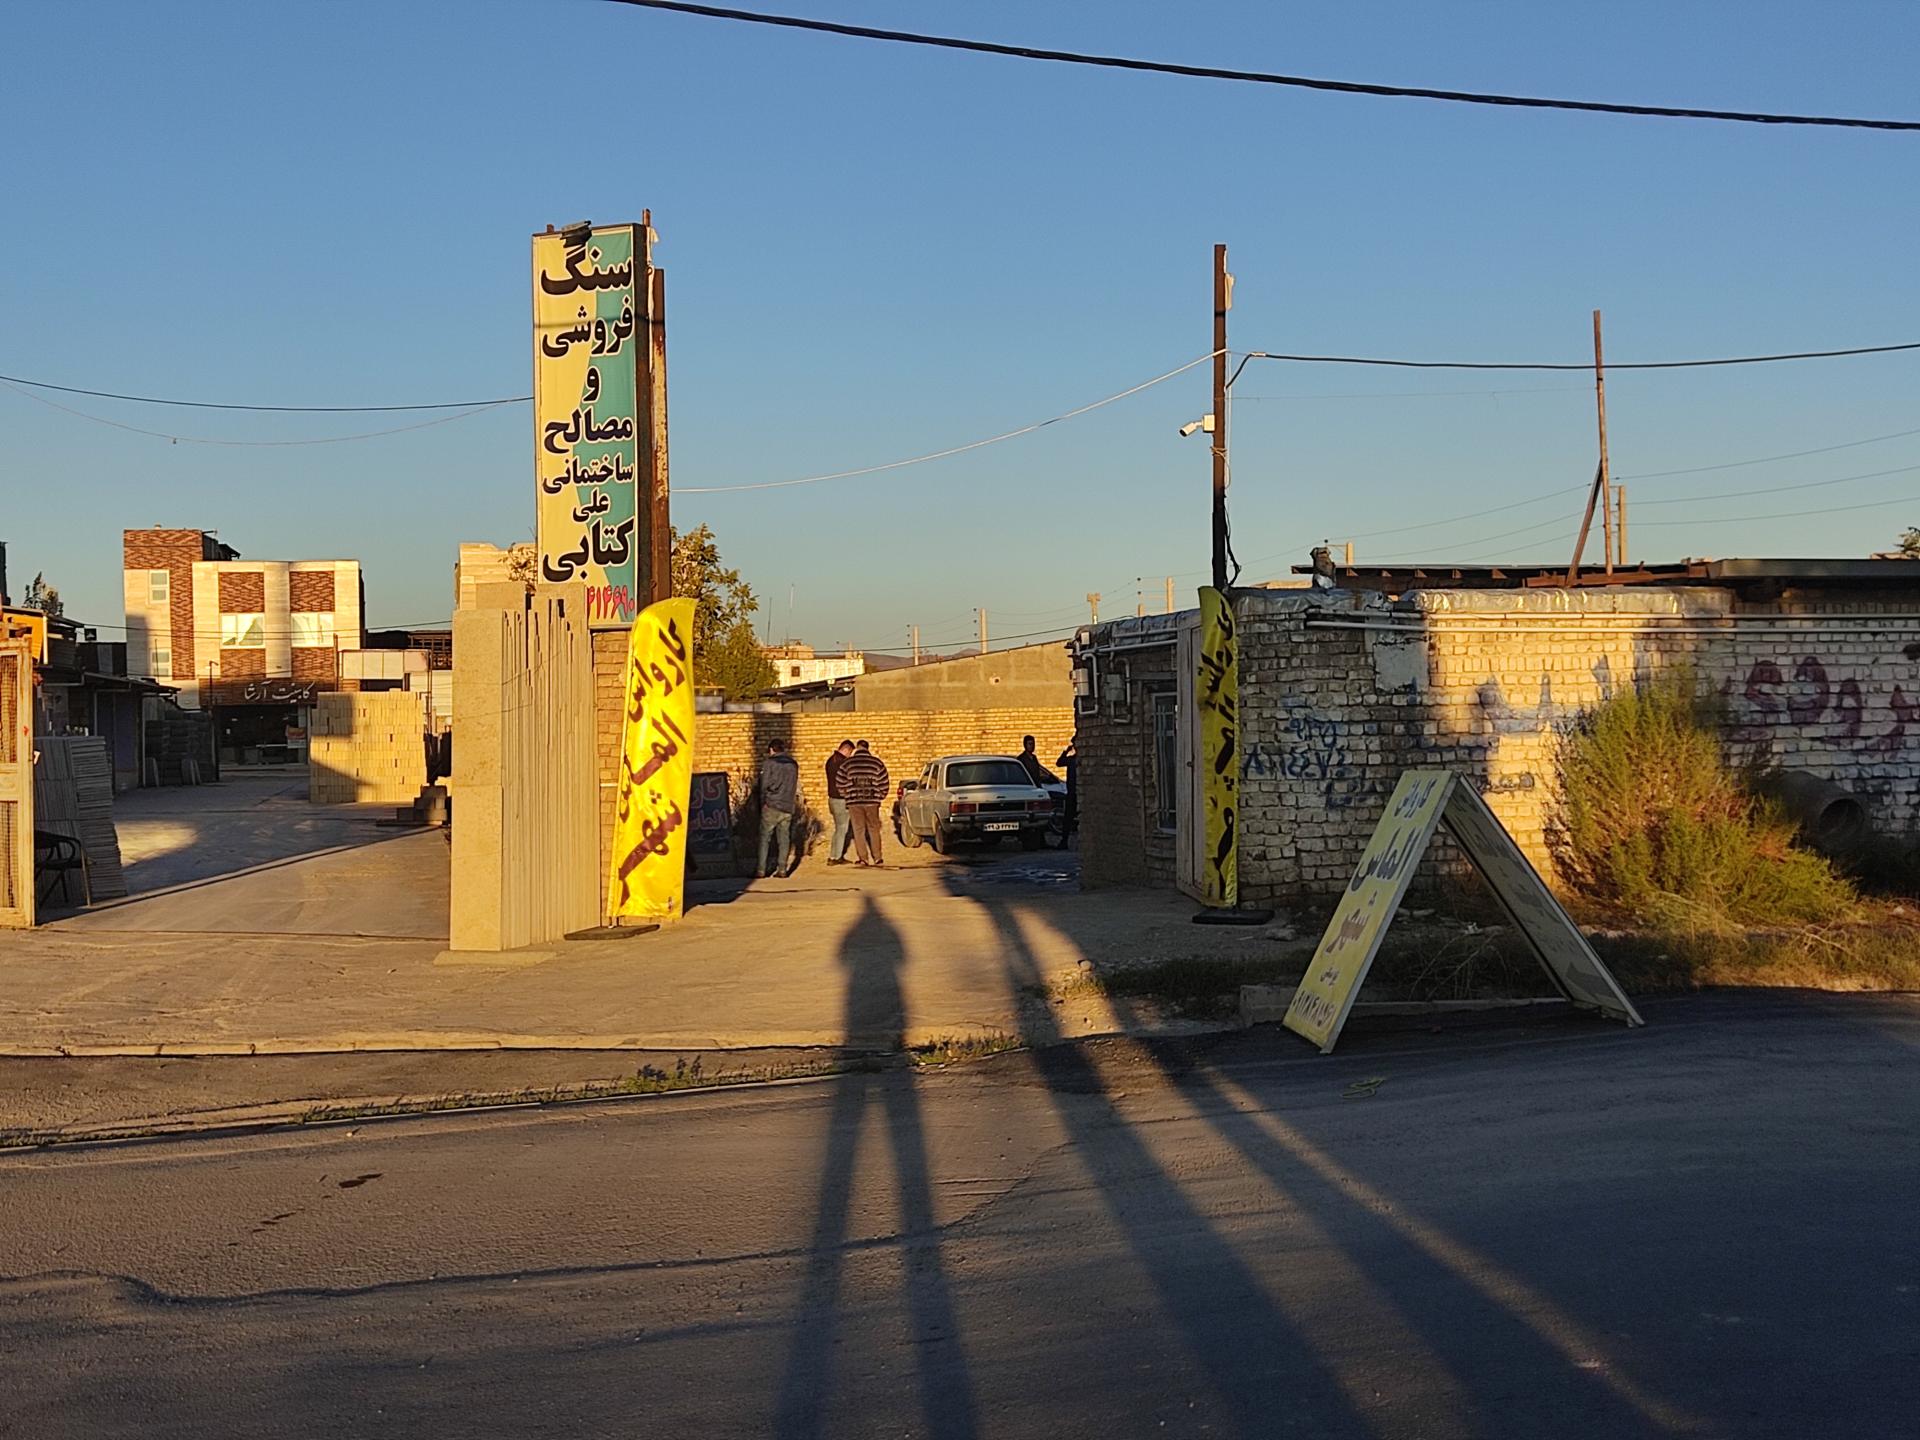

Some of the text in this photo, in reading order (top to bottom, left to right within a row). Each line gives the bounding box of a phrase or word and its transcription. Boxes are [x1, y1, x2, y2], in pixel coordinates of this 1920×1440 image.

[540, 245, 633, 295] سنگ
[541, 297, 633, 357] فروشی
[583, 365, 602, 402] و
[544, 408, 634, 454] مصالح
[542, 453, 634, 495] ساختمانی
[572, 488, 612, 524] علی
[541, 518, 634, 582] کتابی
[272, 680, 315, 704] کابینت
[618, 788, 683, 908] شهر
[1351, 826, 1421, 892] الماس
[1325, 890, 1378, 953] شهر
